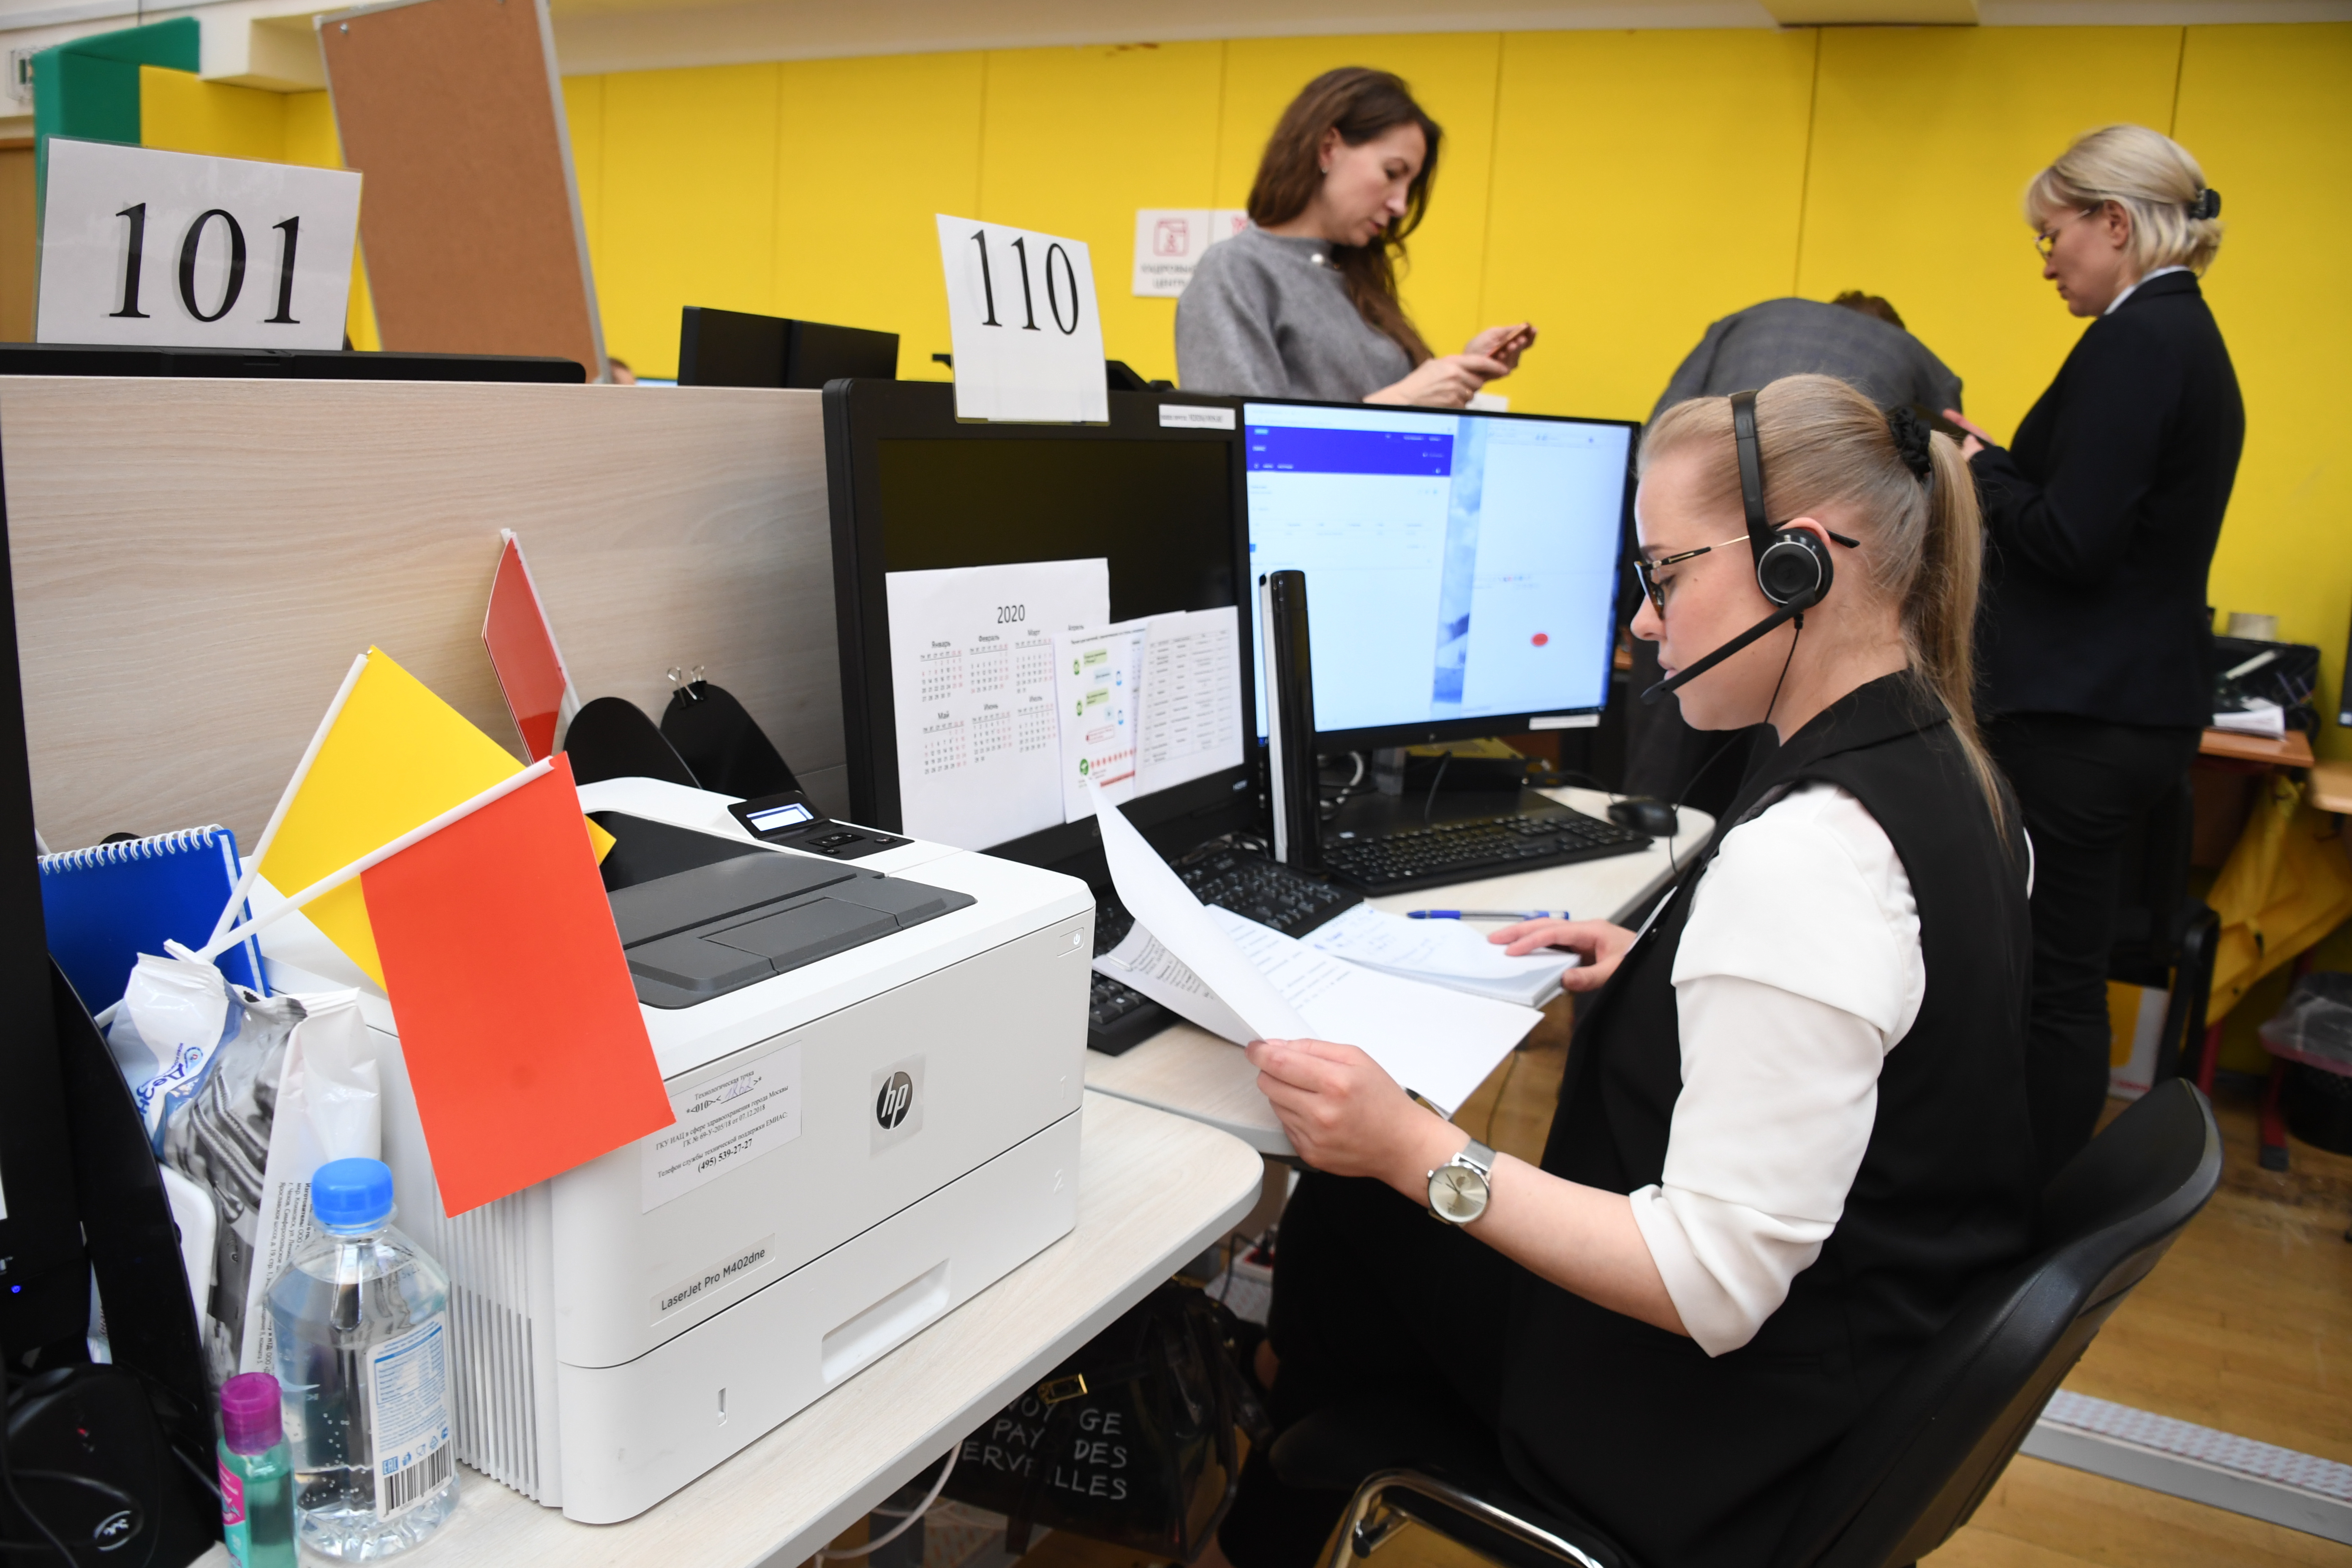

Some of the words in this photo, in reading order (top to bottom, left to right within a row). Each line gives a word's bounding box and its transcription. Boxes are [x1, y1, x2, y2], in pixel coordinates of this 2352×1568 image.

[109, 202, 301, 324] 101
[971, 229, 1079, 336] 110
[997, 604, 1025, 623] 2020
[938, 710, 950, 719] Май
[695, 1078, 739, 1100] Технологическая
[740, 1071, 754, 1080] точка
[881, 1072, 909, 1130] hp
[656, 1140, 668, 1150] ГКУ
[670, 1133, 684, 1144] ИАЦ
[690, 1124, 706, 1135] сфере
[707, 1104, 750, 1127] здравоохранения
[751, 1095, 768, 1107] города
[769, 1086, 789, 1098] Москвы
[739, 1104, 765, 1121] 07.12.2018
[658, 1164, 681, 1178] Телефон
[683, 1153, 703, 1167] службы
[705, 1137, 737, 1156] технической
[738, 1123, 765, 1140] поддержки
[766, 1112, 788, 1127] ЕМИАС:
[698, 1157, 716, 1173] (495)
[719, 1138, 752, 1162] 539-27-27
[275, 1182, 286, 1220] Ярославское
[284, 1188, 293, 1207] Чехов,
[290, 1198, 299, 1228] Климовск,
[299, 1183, 311, 1227] Изготовитель:
[277, 1209, 291, 1263] Симферопольское
[661, 1282, 701, 1311] LaserJet
[705, 1273, 720, 1288] Pro
[723, 1249, 765, 1278] M402dne
[1074, 1438, 1128, 1469] DES
